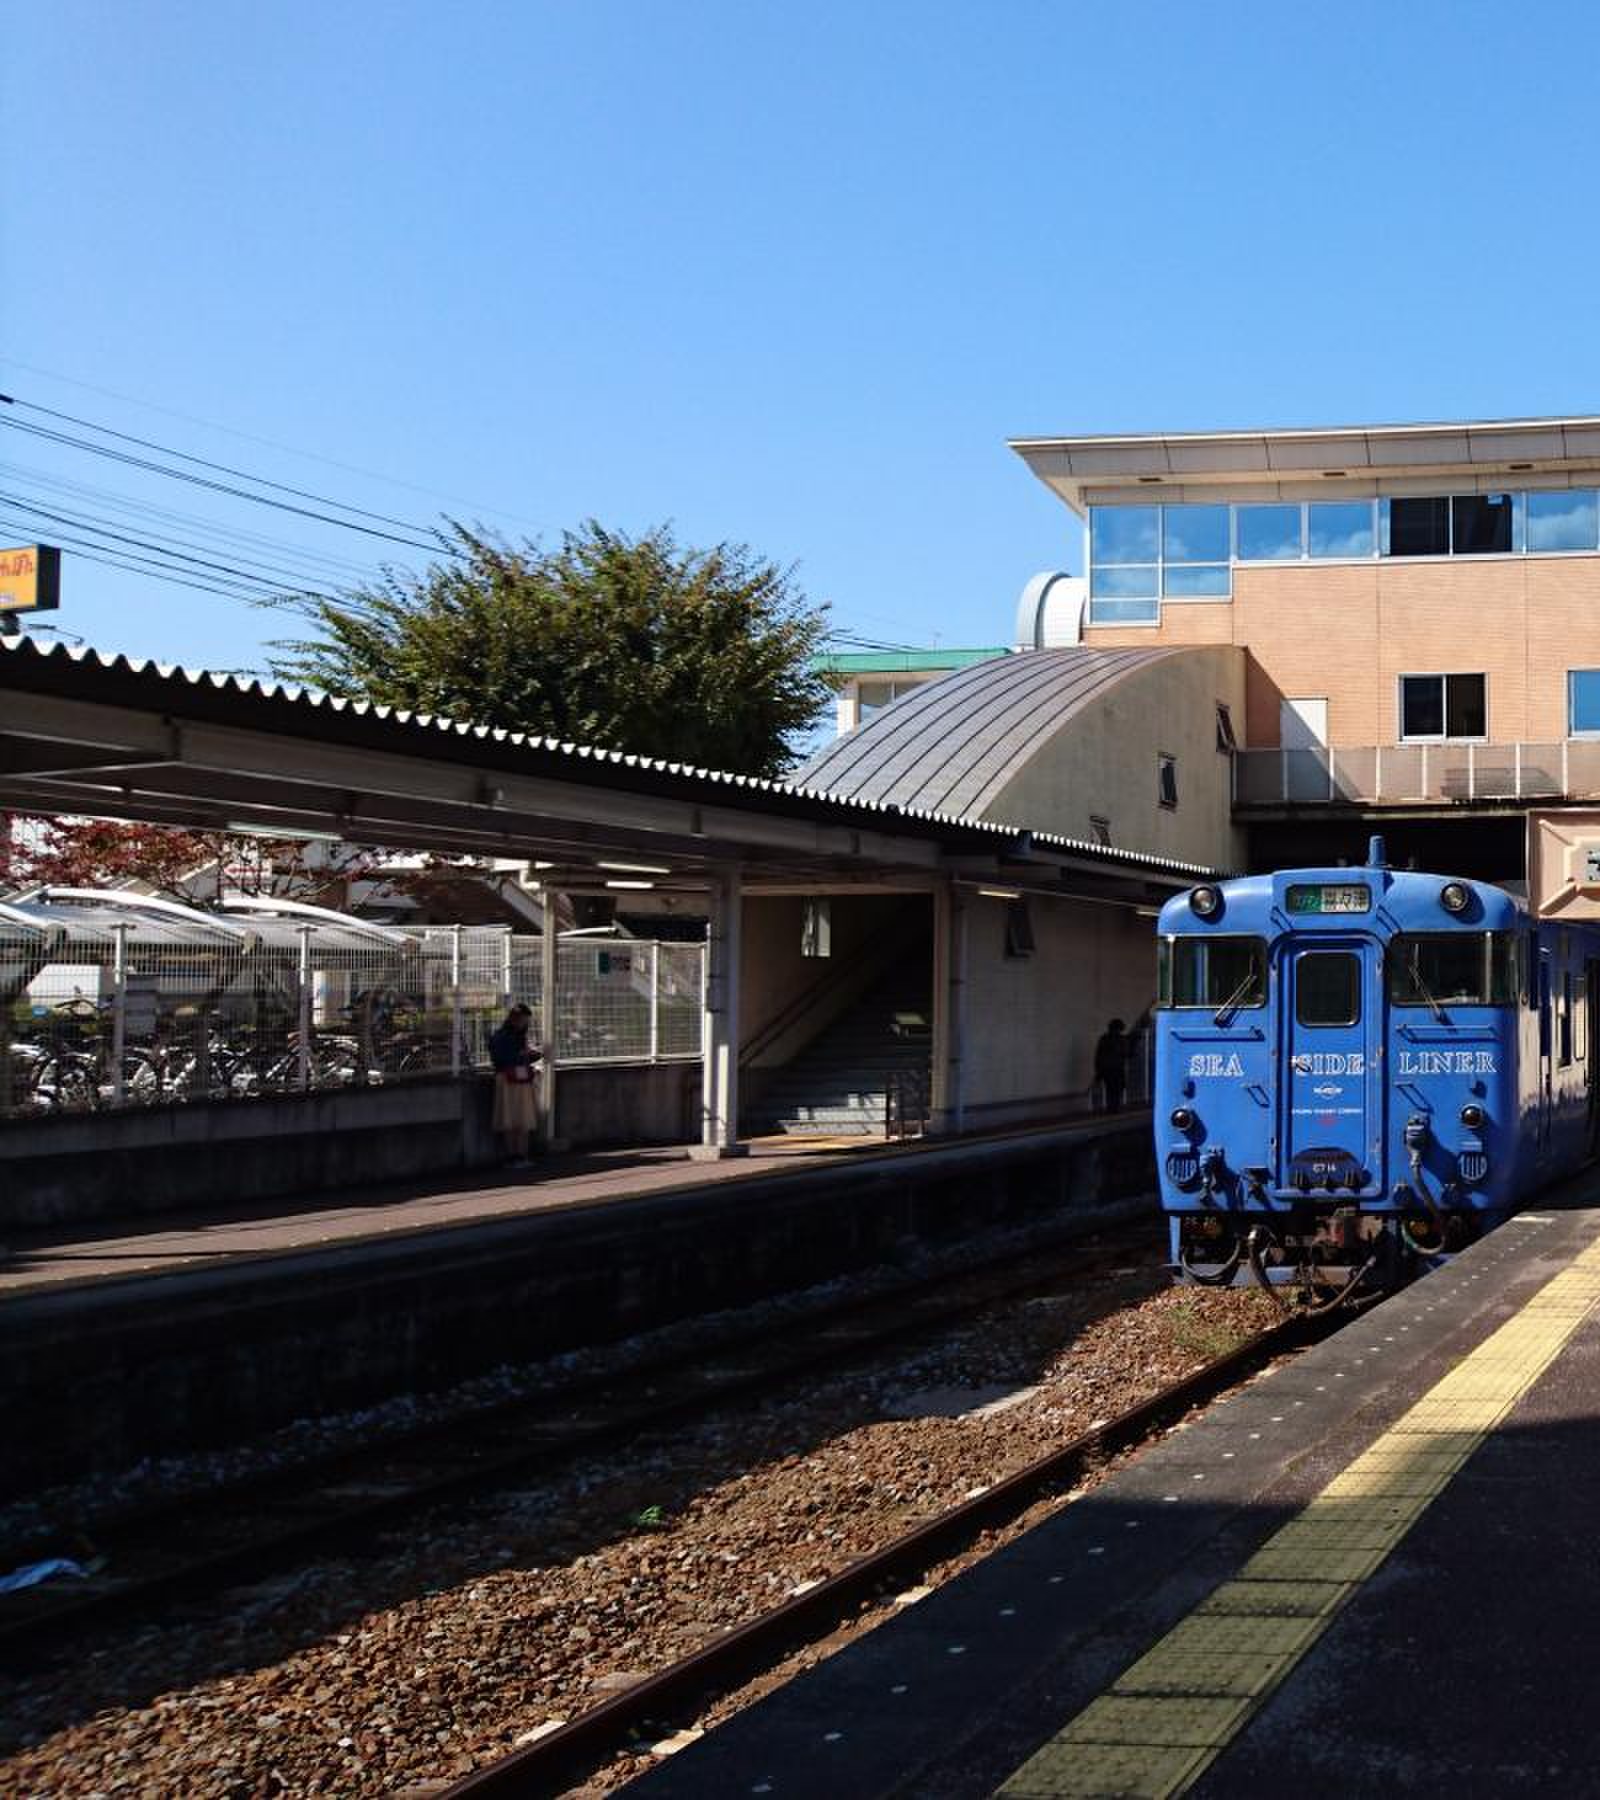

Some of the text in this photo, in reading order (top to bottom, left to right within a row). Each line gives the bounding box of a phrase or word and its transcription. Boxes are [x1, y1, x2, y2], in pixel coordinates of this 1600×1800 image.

[1189, 1050, 1498, 1077] SEA SIDE LINER
